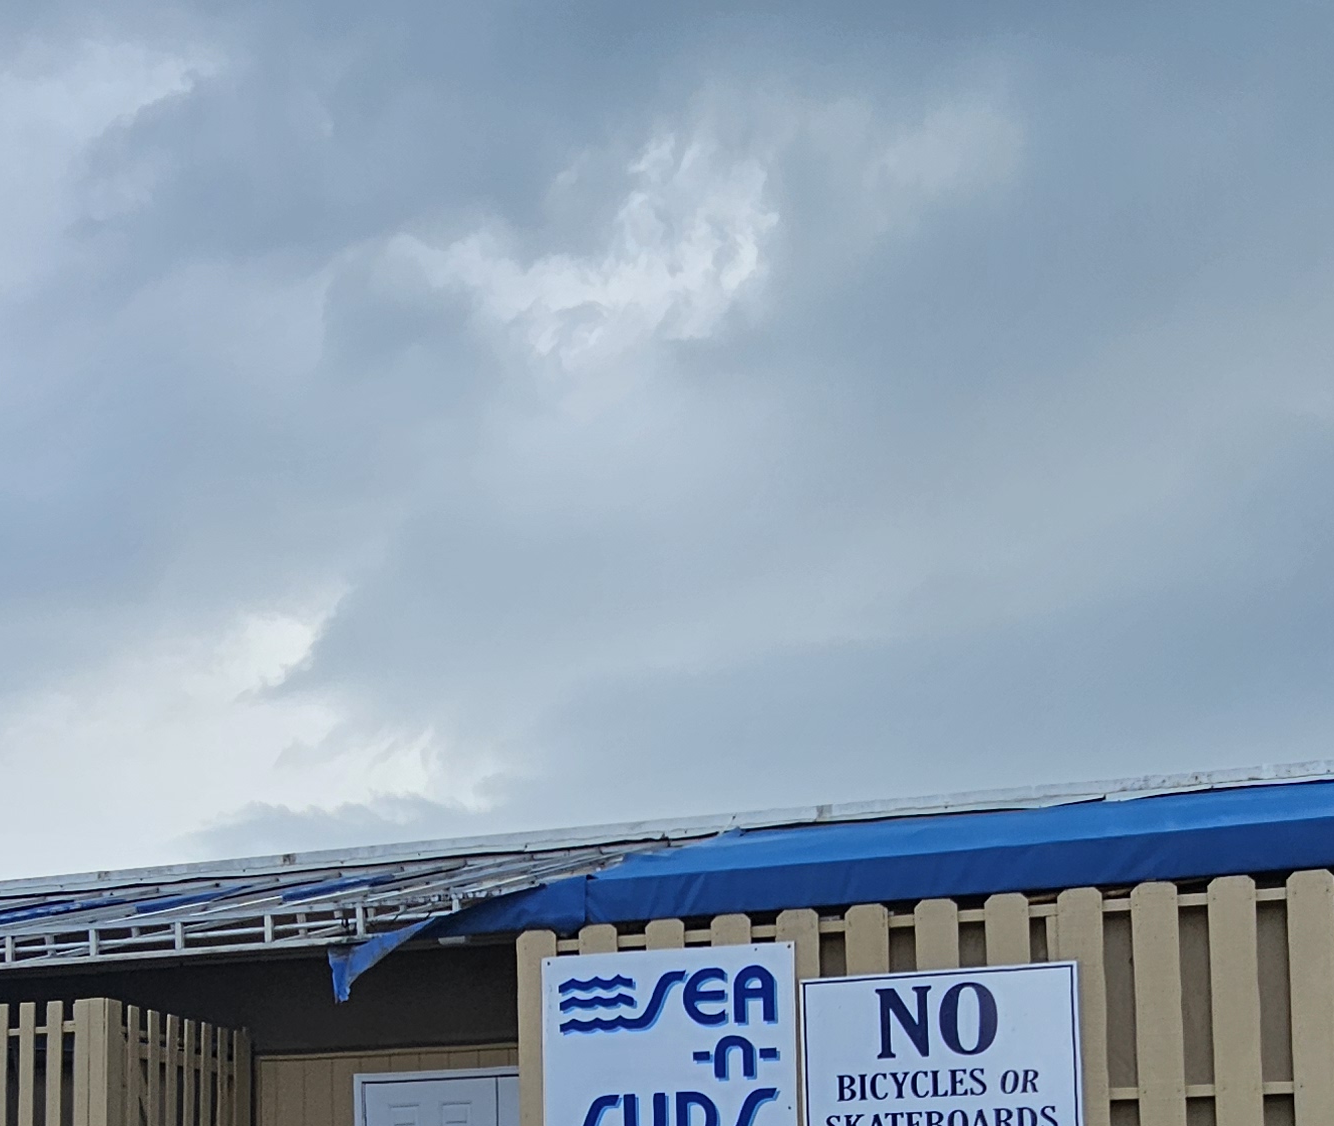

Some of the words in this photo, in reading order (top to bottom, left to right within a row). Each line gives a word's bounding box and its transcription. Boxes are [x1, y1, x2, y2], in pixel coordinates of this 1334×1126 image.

[558, 965, 778, 1036] SEA
[874, 981, 998, 1060] NO
[836, 1068, 987, 1102] BICYCLES
[1000, 1069, 1039, 1094] OR
